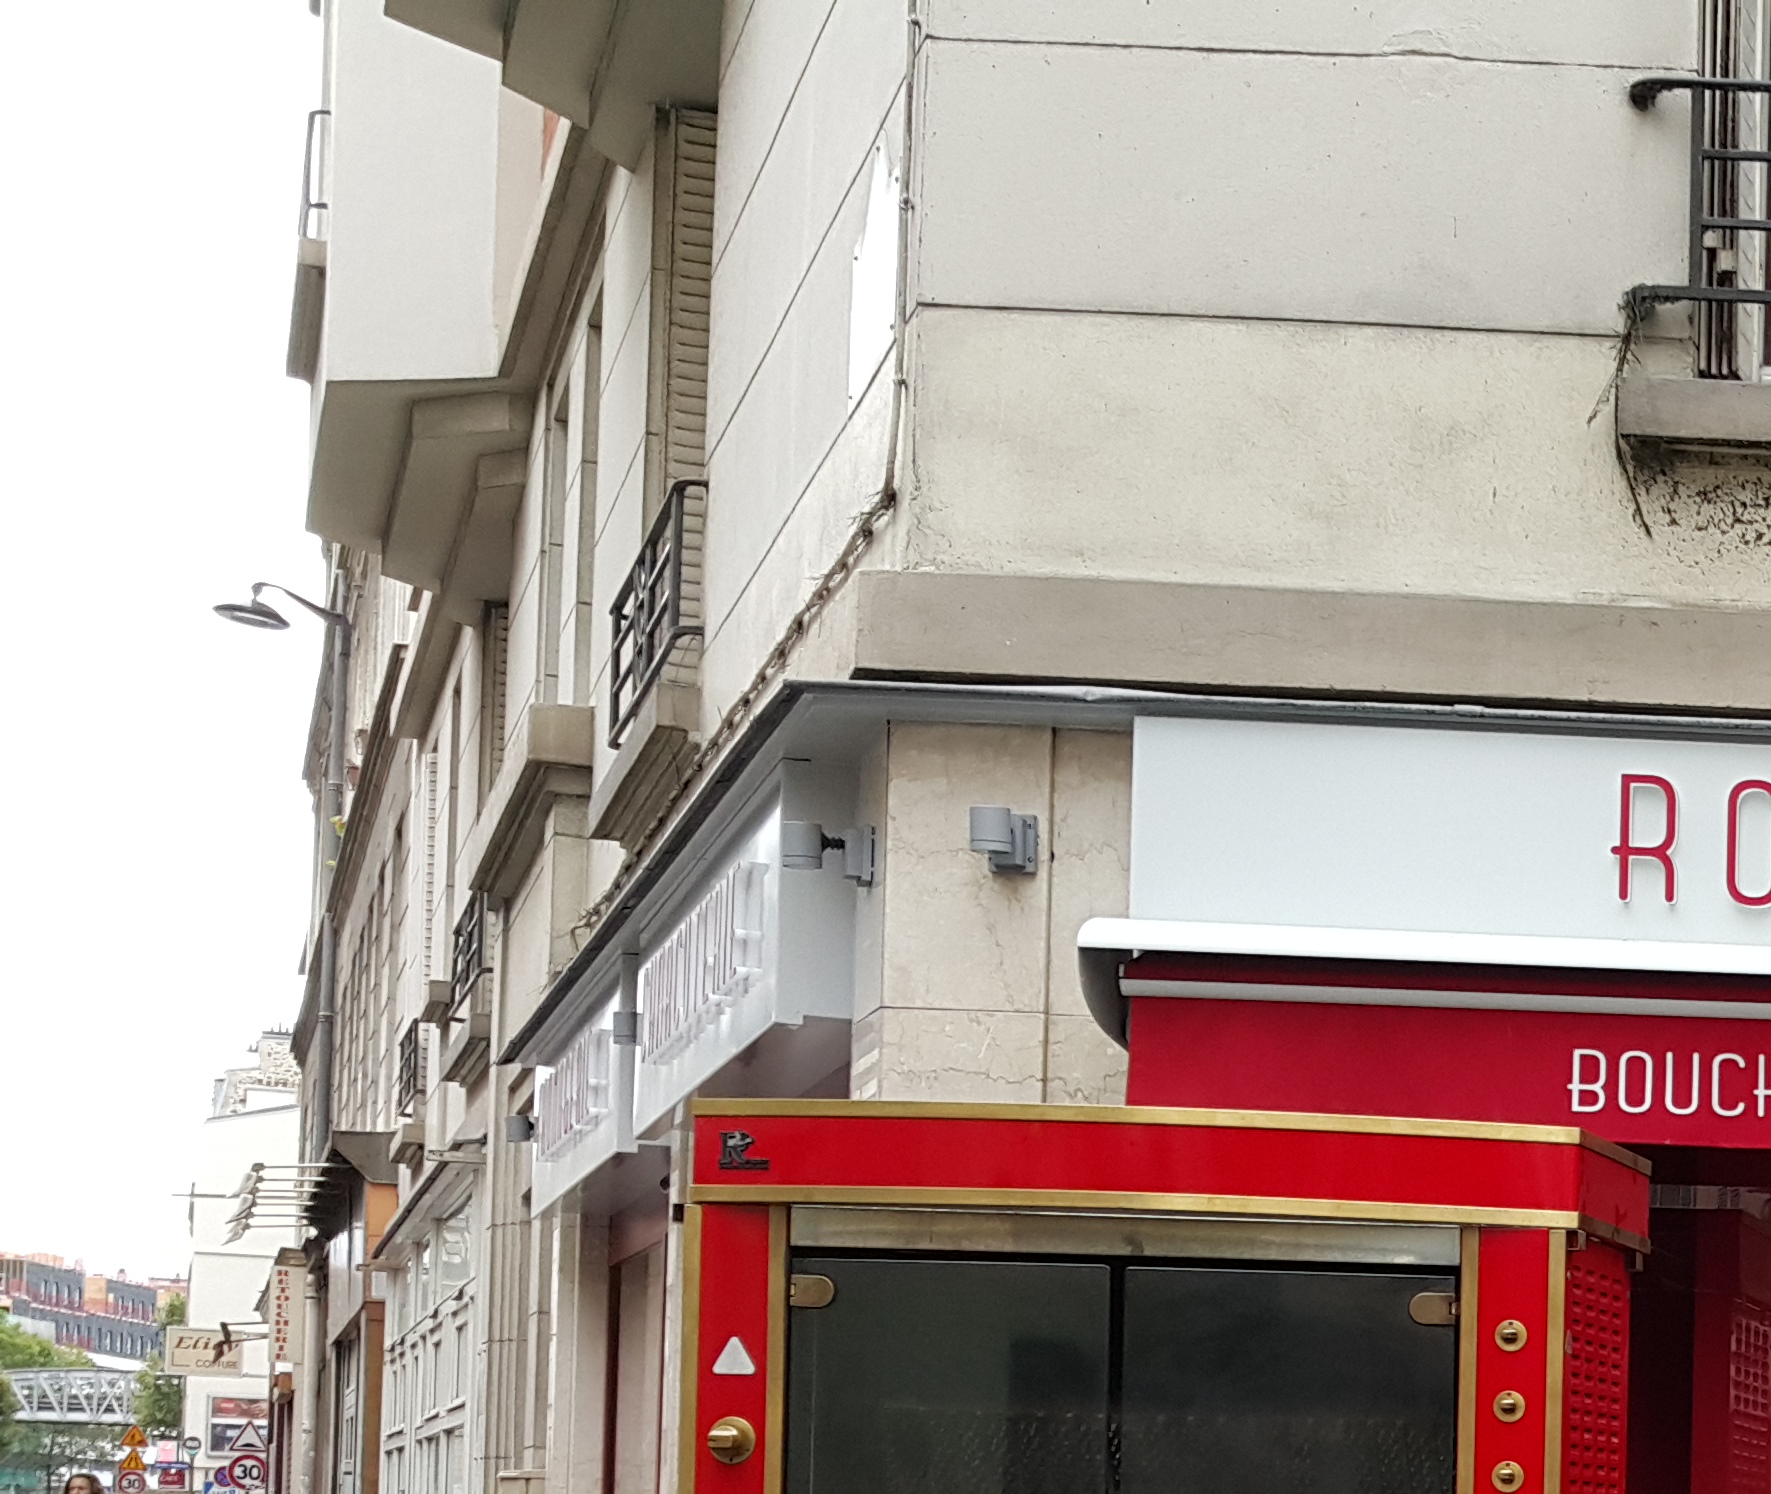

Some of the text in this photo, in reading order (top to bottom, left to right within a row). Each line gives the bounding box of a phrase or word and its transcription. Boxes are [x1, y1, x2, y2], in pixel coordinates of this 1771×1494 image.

[275, 1269, 289, 1360] RETOUCHERIE
[235, 1463, 261, 1480] 30
[124, 1478, 141, 1490] 30
